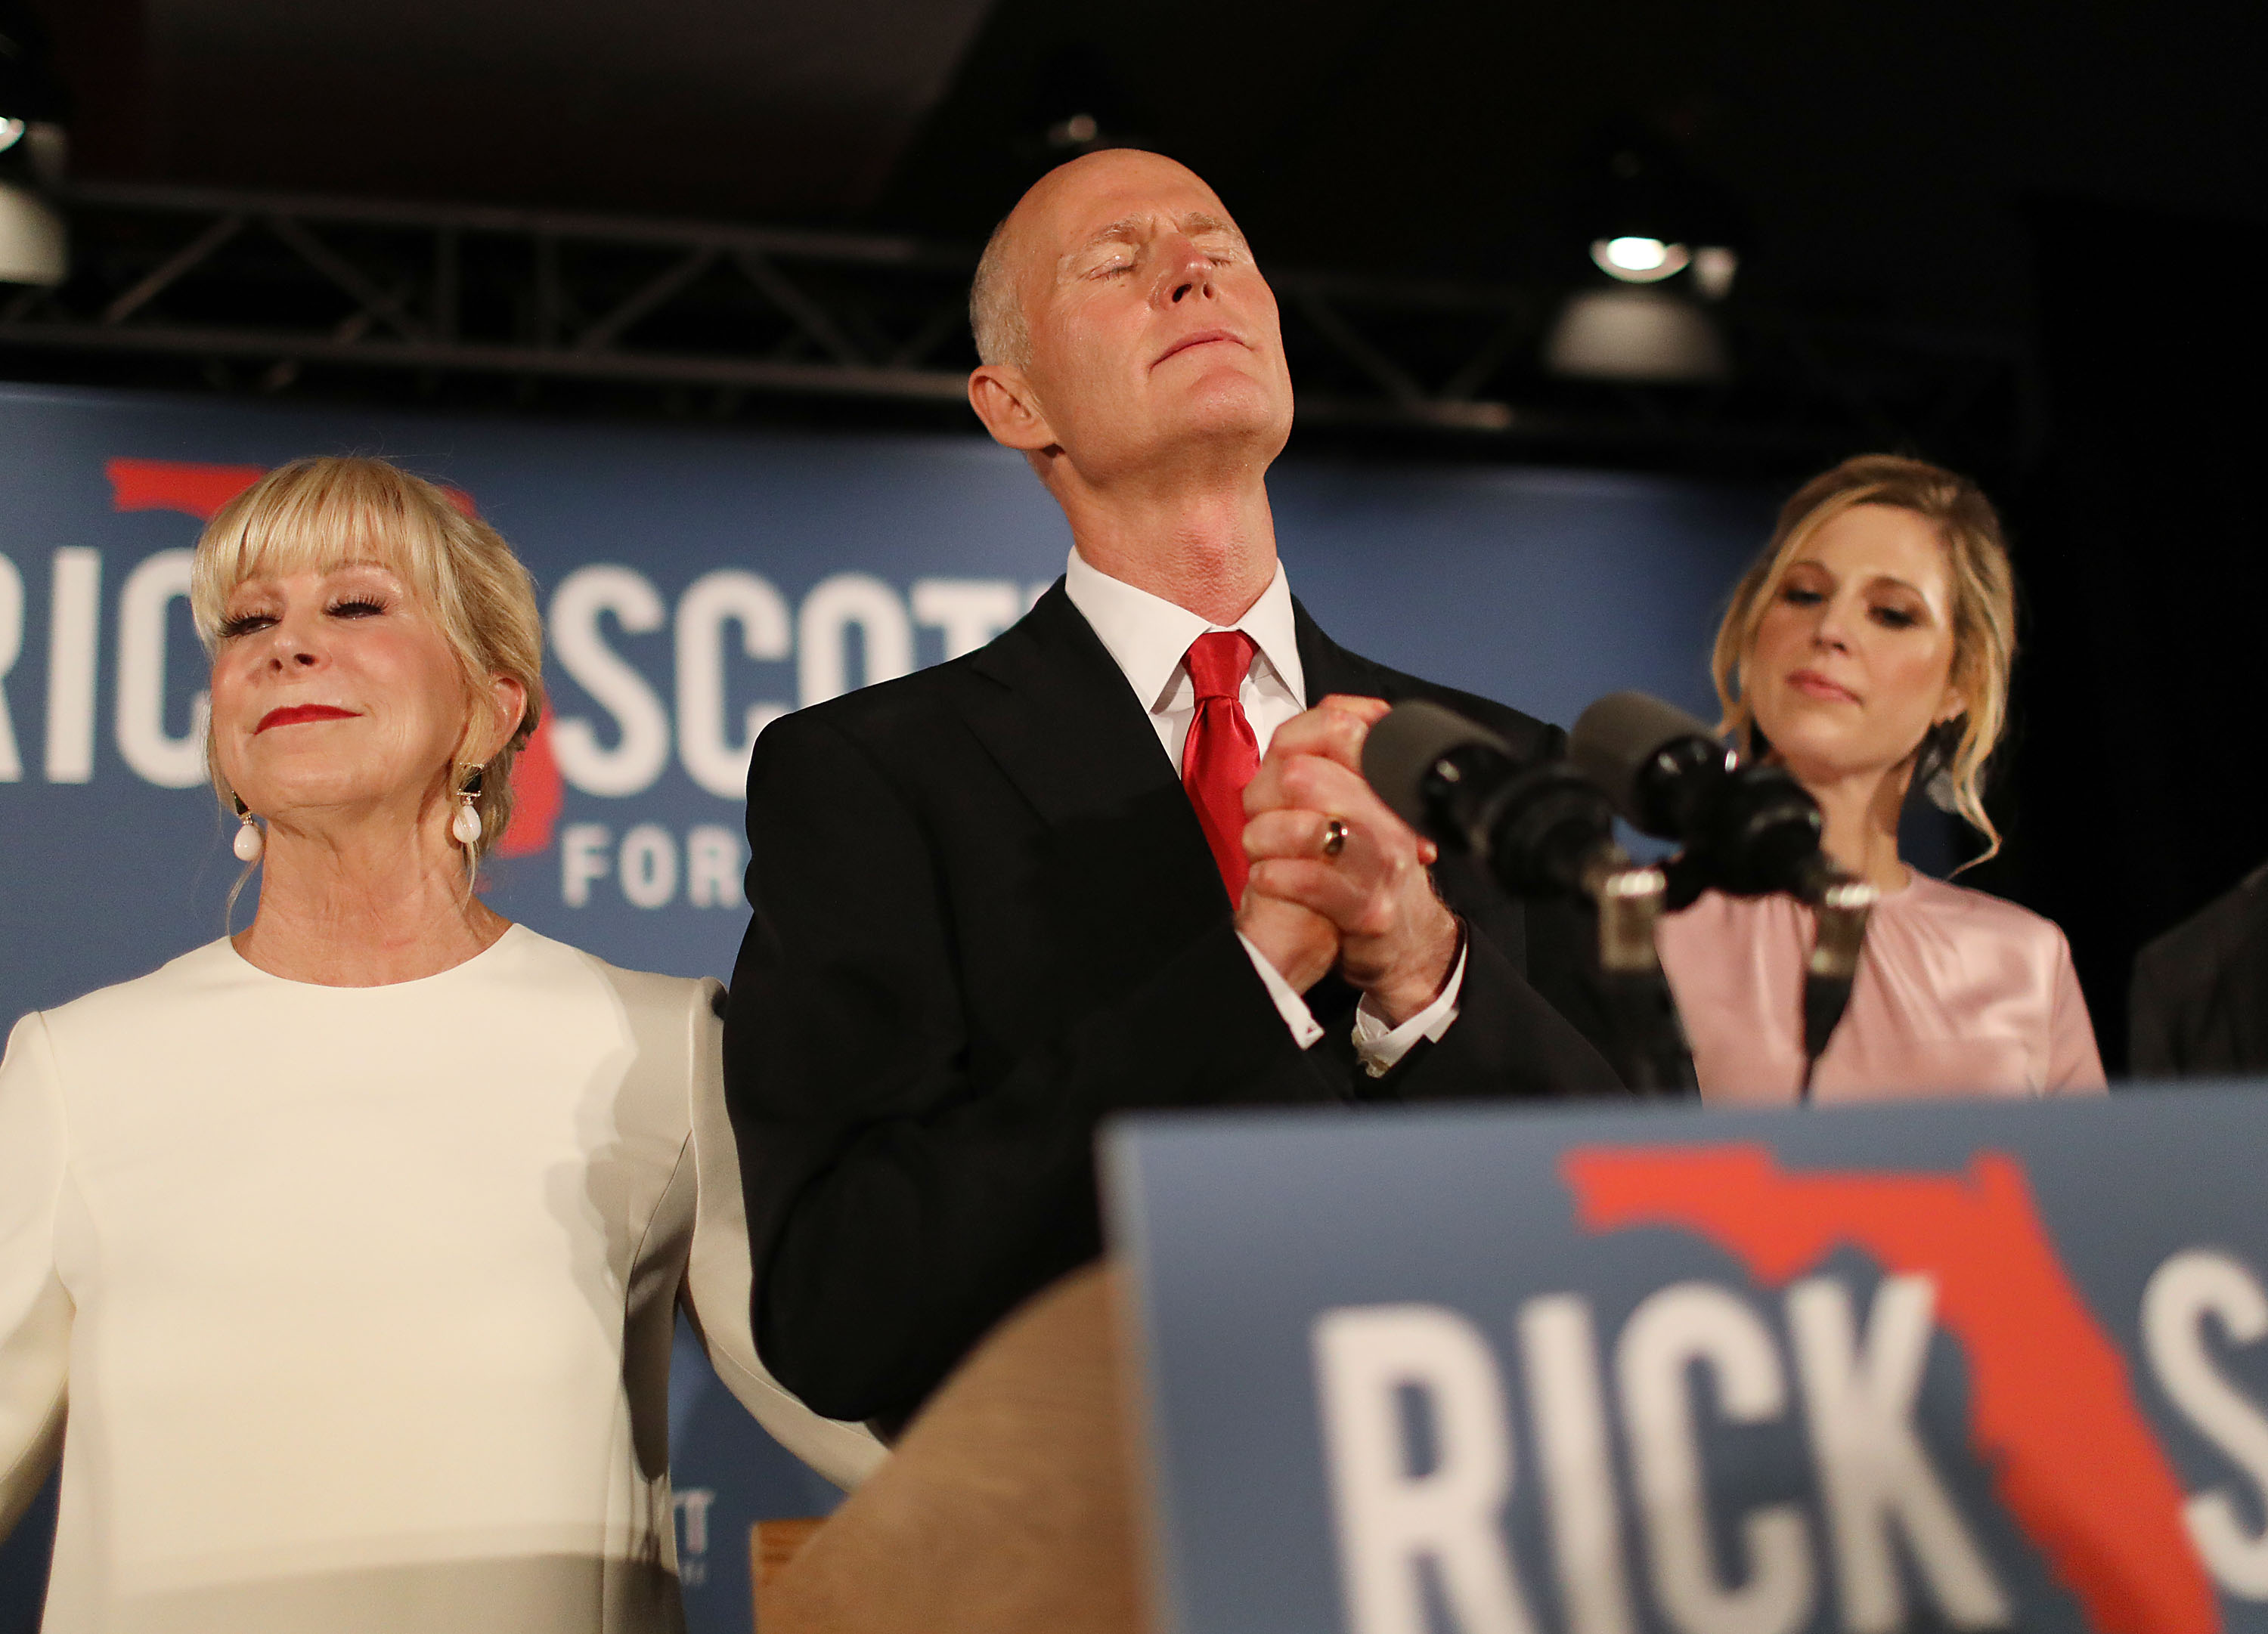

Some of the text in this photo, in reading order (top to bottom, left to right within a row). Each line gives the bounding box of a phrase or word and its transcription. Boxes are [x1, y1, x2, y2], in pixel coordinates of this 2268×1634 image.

[551, 563, 1059, 800] SCOT
[562, 823, 748, 910] FOR
[1313, 1270, 2011, 1634] RICK
